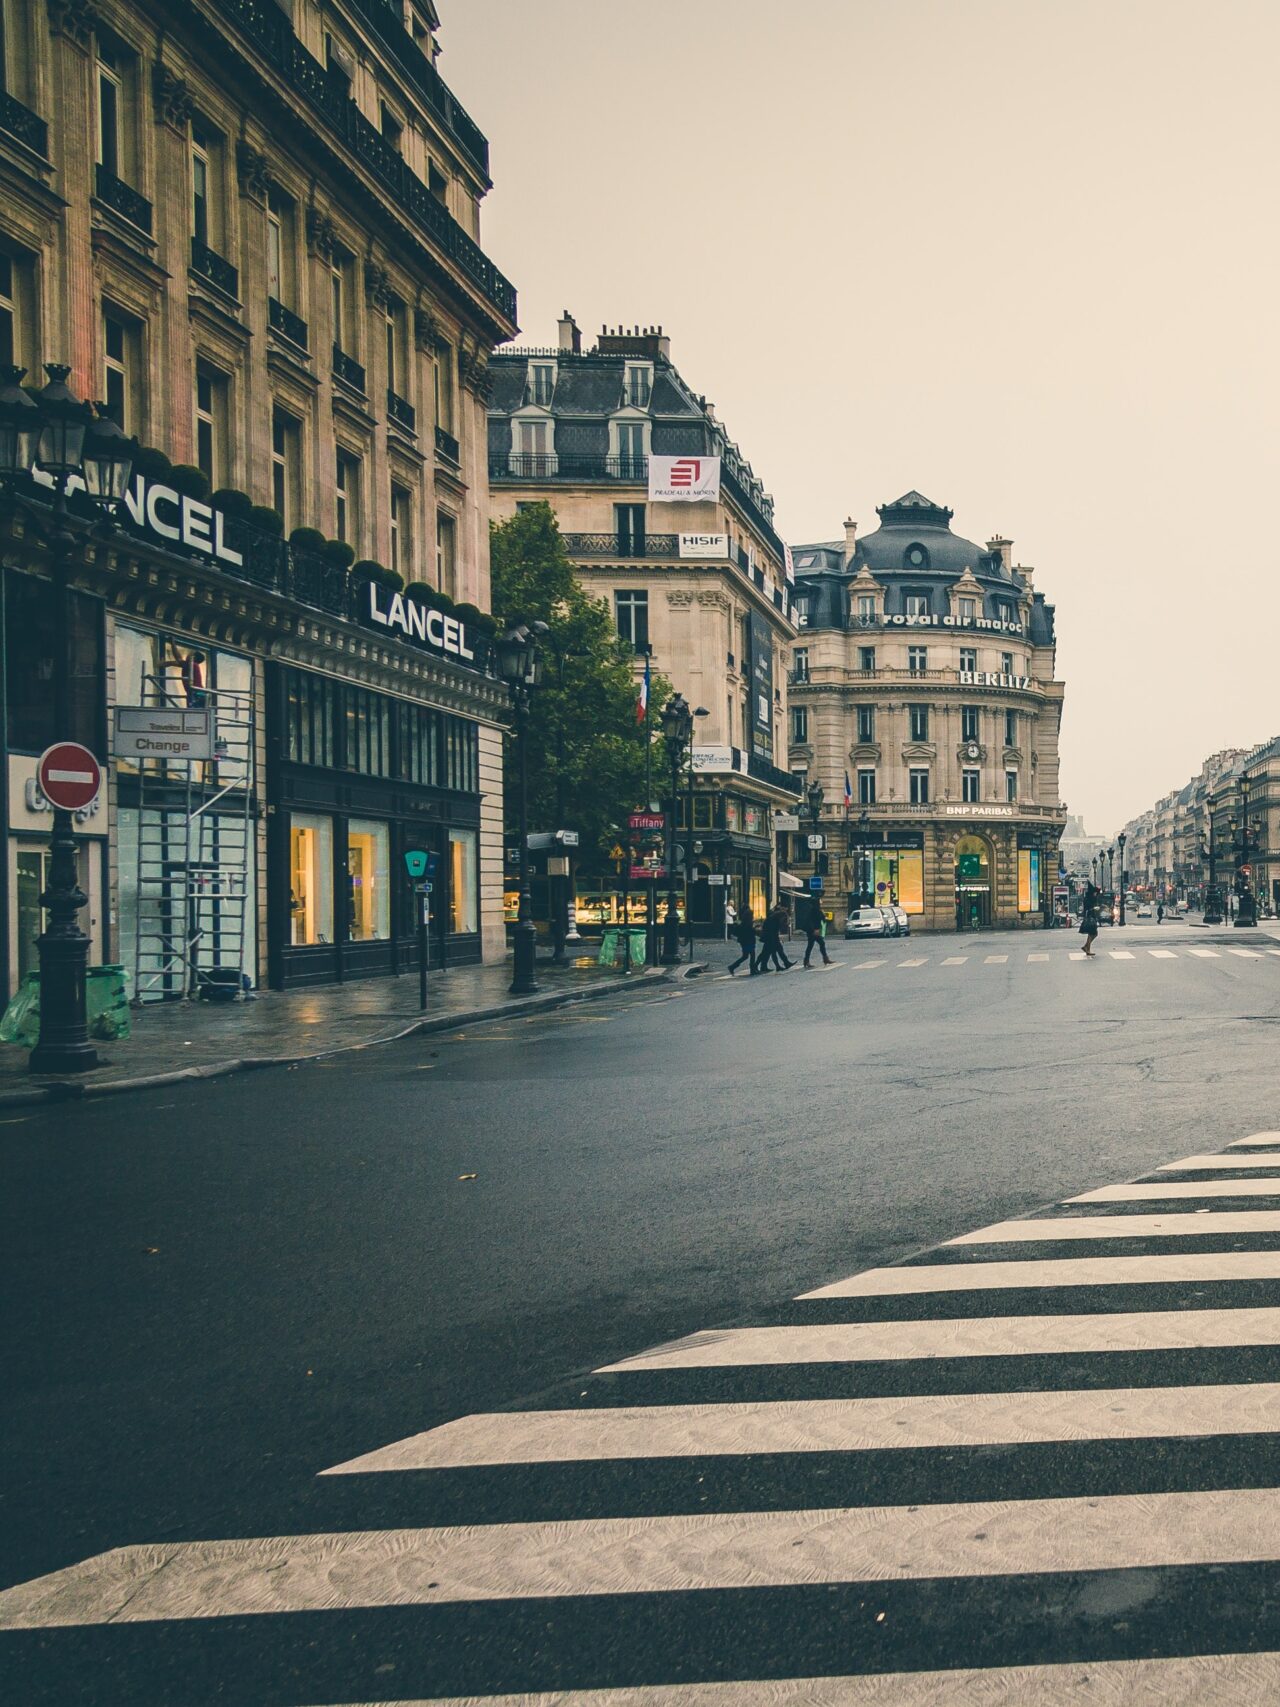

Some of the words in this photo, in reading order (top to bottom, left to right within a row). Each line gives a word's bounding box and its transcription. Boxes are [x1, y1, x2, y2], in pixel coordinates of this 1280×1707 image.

[682, 536, 724, 546] HISIF
[370, 581, 473, 660] LANCEL
[883, 614, 938, 626] royal
[943, 615, 971, 626] air
[976, 618, 1022, 632] maroc
[960, 670, 1031, 690] BERLITZ
[136, 738, 190, 754] Change
[946, 806, 969, 815] BNP
[971, 807, 1013, 816] PARIBAS
[634, 818, 665, 830] Tiffany
